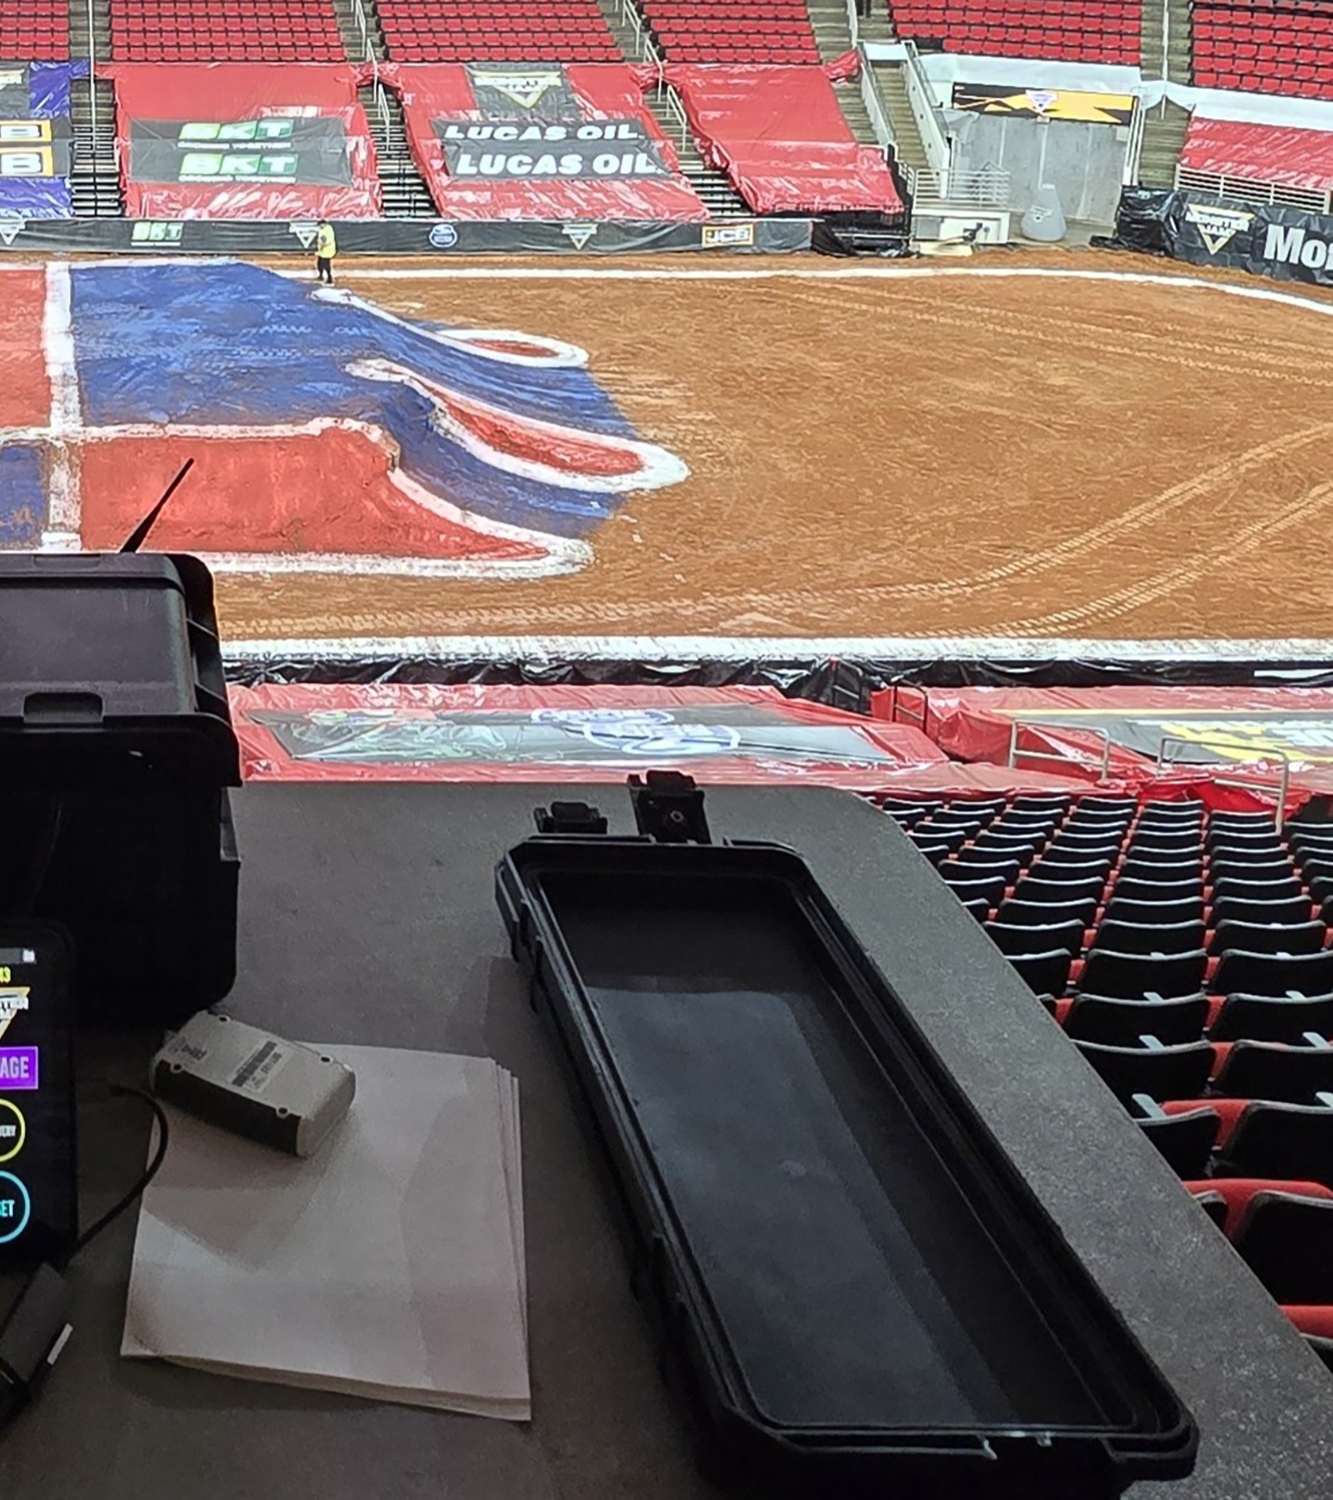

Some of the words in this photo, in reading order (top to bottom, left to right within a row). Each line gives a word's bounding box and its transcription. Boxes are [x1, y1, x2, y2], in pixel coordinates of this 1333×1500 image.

[178, 119, 294, 141] BKT
[444, 125, 567, 141] LUCAS
[179, 153, 299, 175] BKT
[455, 153, 583, 175] LUCAS
[705, 227, 750, 243] JCB
